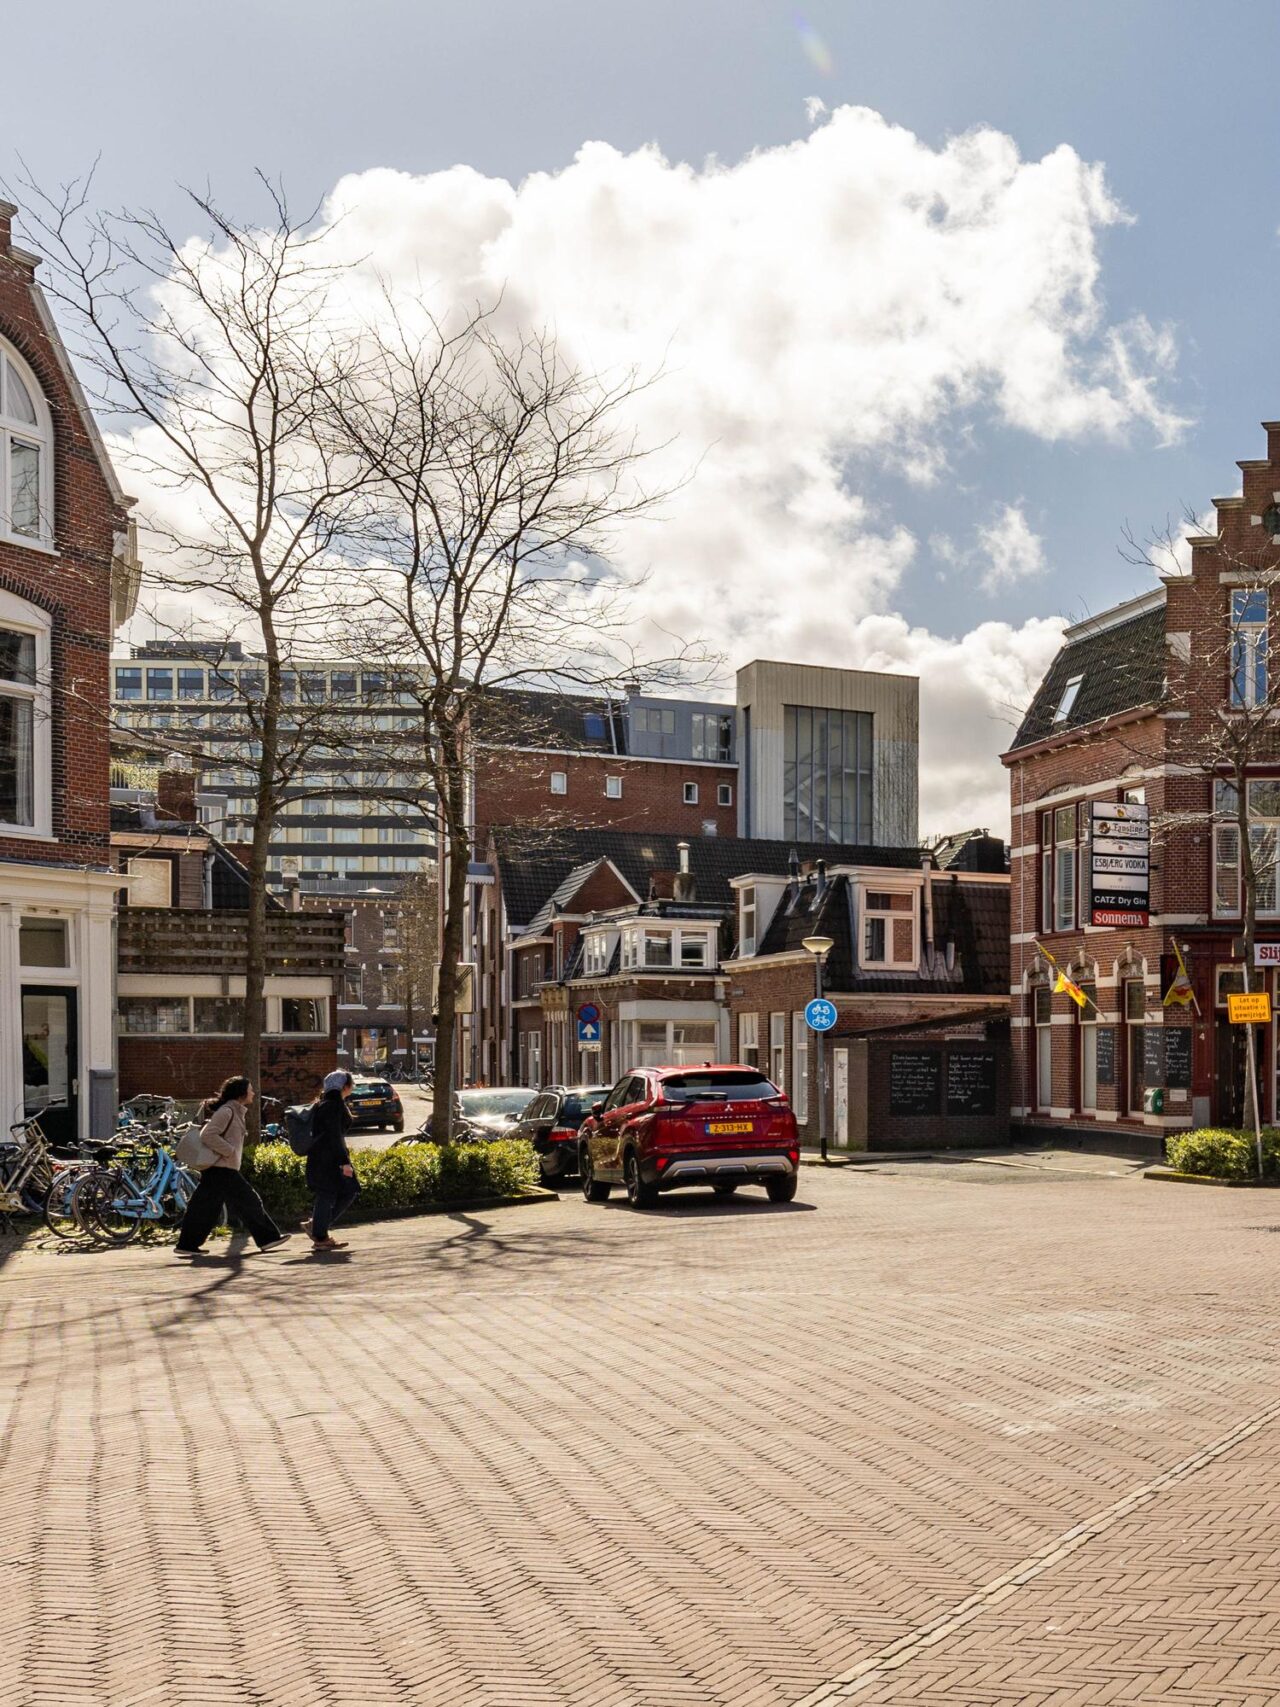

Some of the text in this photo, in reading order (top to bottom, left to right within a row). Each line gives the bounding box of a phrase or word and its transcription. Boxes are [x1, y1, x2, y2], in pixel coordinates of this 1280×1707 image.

[1125, 859, 1146, 869] VODKA
[1094, 895, 1147, 907] CATZ Dry Gin
[1199, 1032, 1206, 1041] 4
[713, 1123, 749, 1132] Z-313-HX
